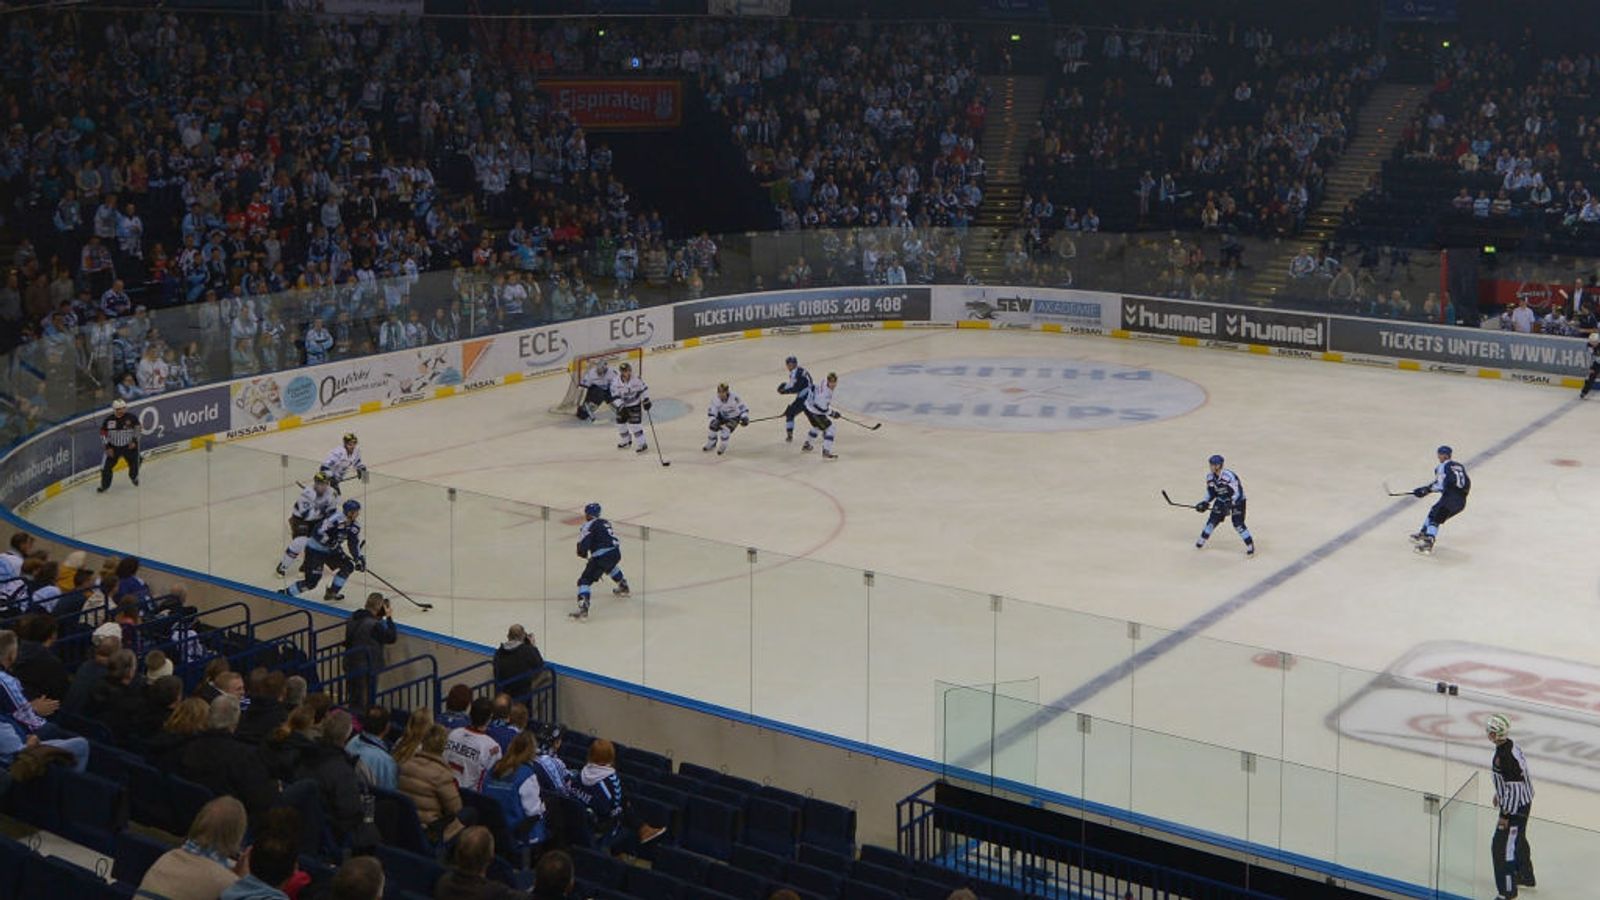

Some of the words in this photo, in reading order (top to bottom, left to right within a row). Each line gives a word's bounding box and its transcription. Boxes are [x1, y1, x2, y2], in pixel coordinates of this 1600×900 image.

[798, 298, 839, 317] 01805
[843, 297, 871, 315] 208
[996, 294, 1032, 313] SEW
[608, 314, 646, 342] ECE
[1138, 304, 1217, 335] hummel
[1240, 313, 1323, 347] hummel
[518, 329, 559, 359] ECE
[1378, 330, 1444, 356] TICKETS
[1447, 337, 1505, 361] UNTER:
[463, 379, 496, 392] NISSAN
[173, 403, 220, 429] World
[862, 401, 1160, 423] PHILIPS
[226, 425, 267, 439] NISSAN
